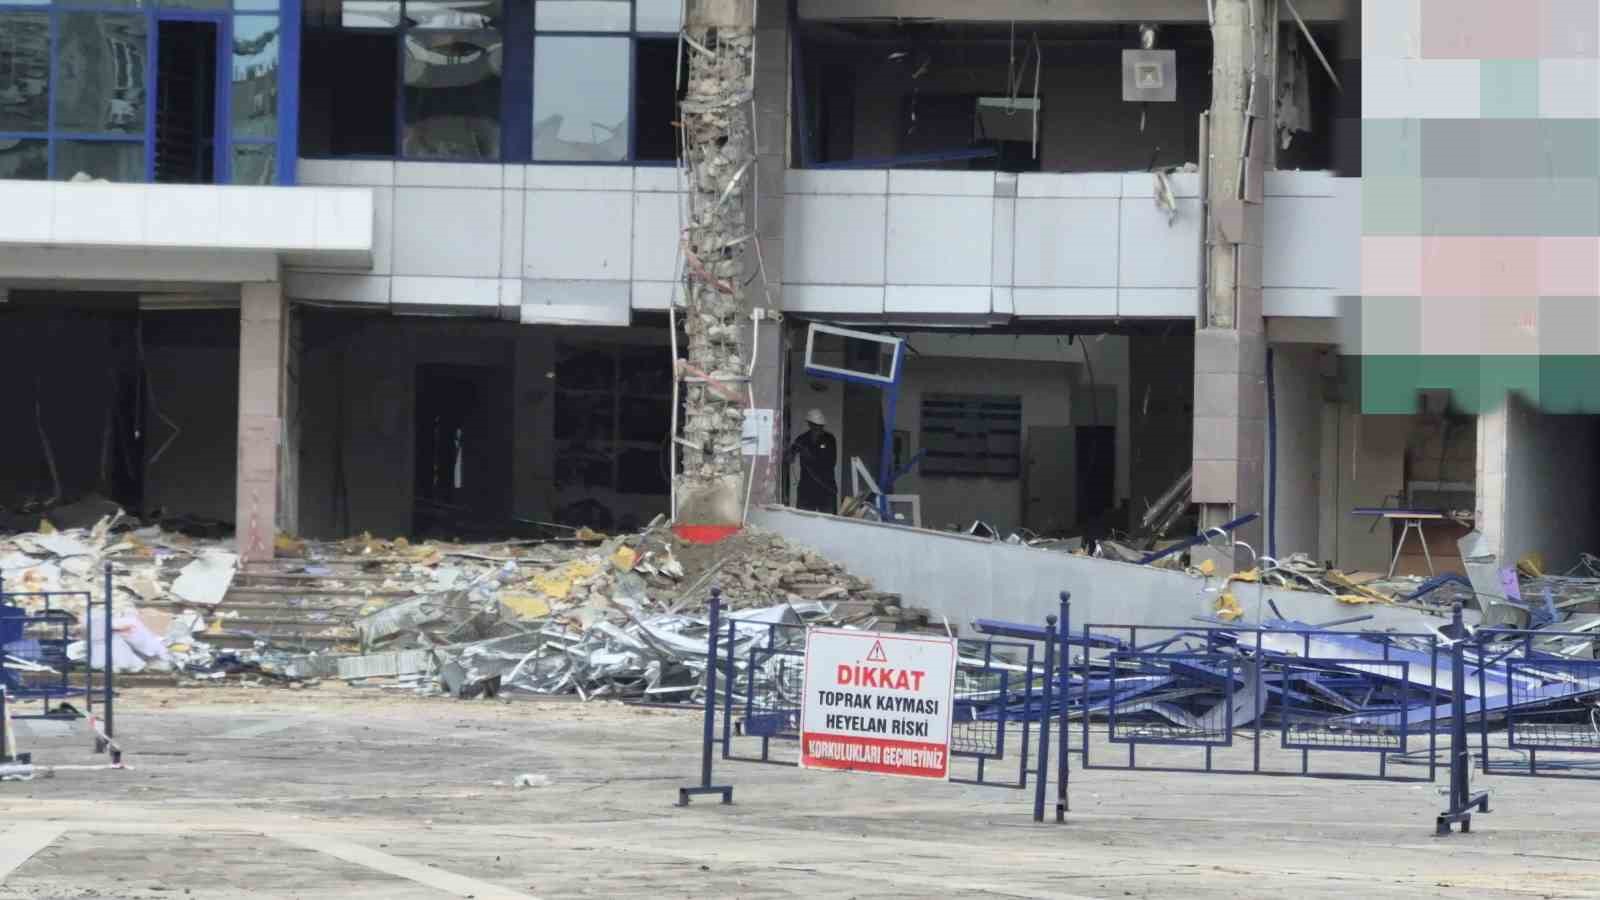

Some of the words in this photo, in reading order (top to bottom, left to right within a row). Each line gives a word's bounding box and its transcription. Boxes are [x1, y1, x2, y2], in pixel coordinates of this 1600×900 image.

[837, 660, 924, 692] DİKKAT
[818, 690, 872, 710] TOPRAK
[876, 695, 939, 715] KAYMASI
[826, 714, 887, 734] HEYELAN
[892, 716, 928, 737] RİSKİ
[808, 740, 881, 765] KORKULUKLARI
[883, 746, 944, 769] GEÇMEYİNİZ
